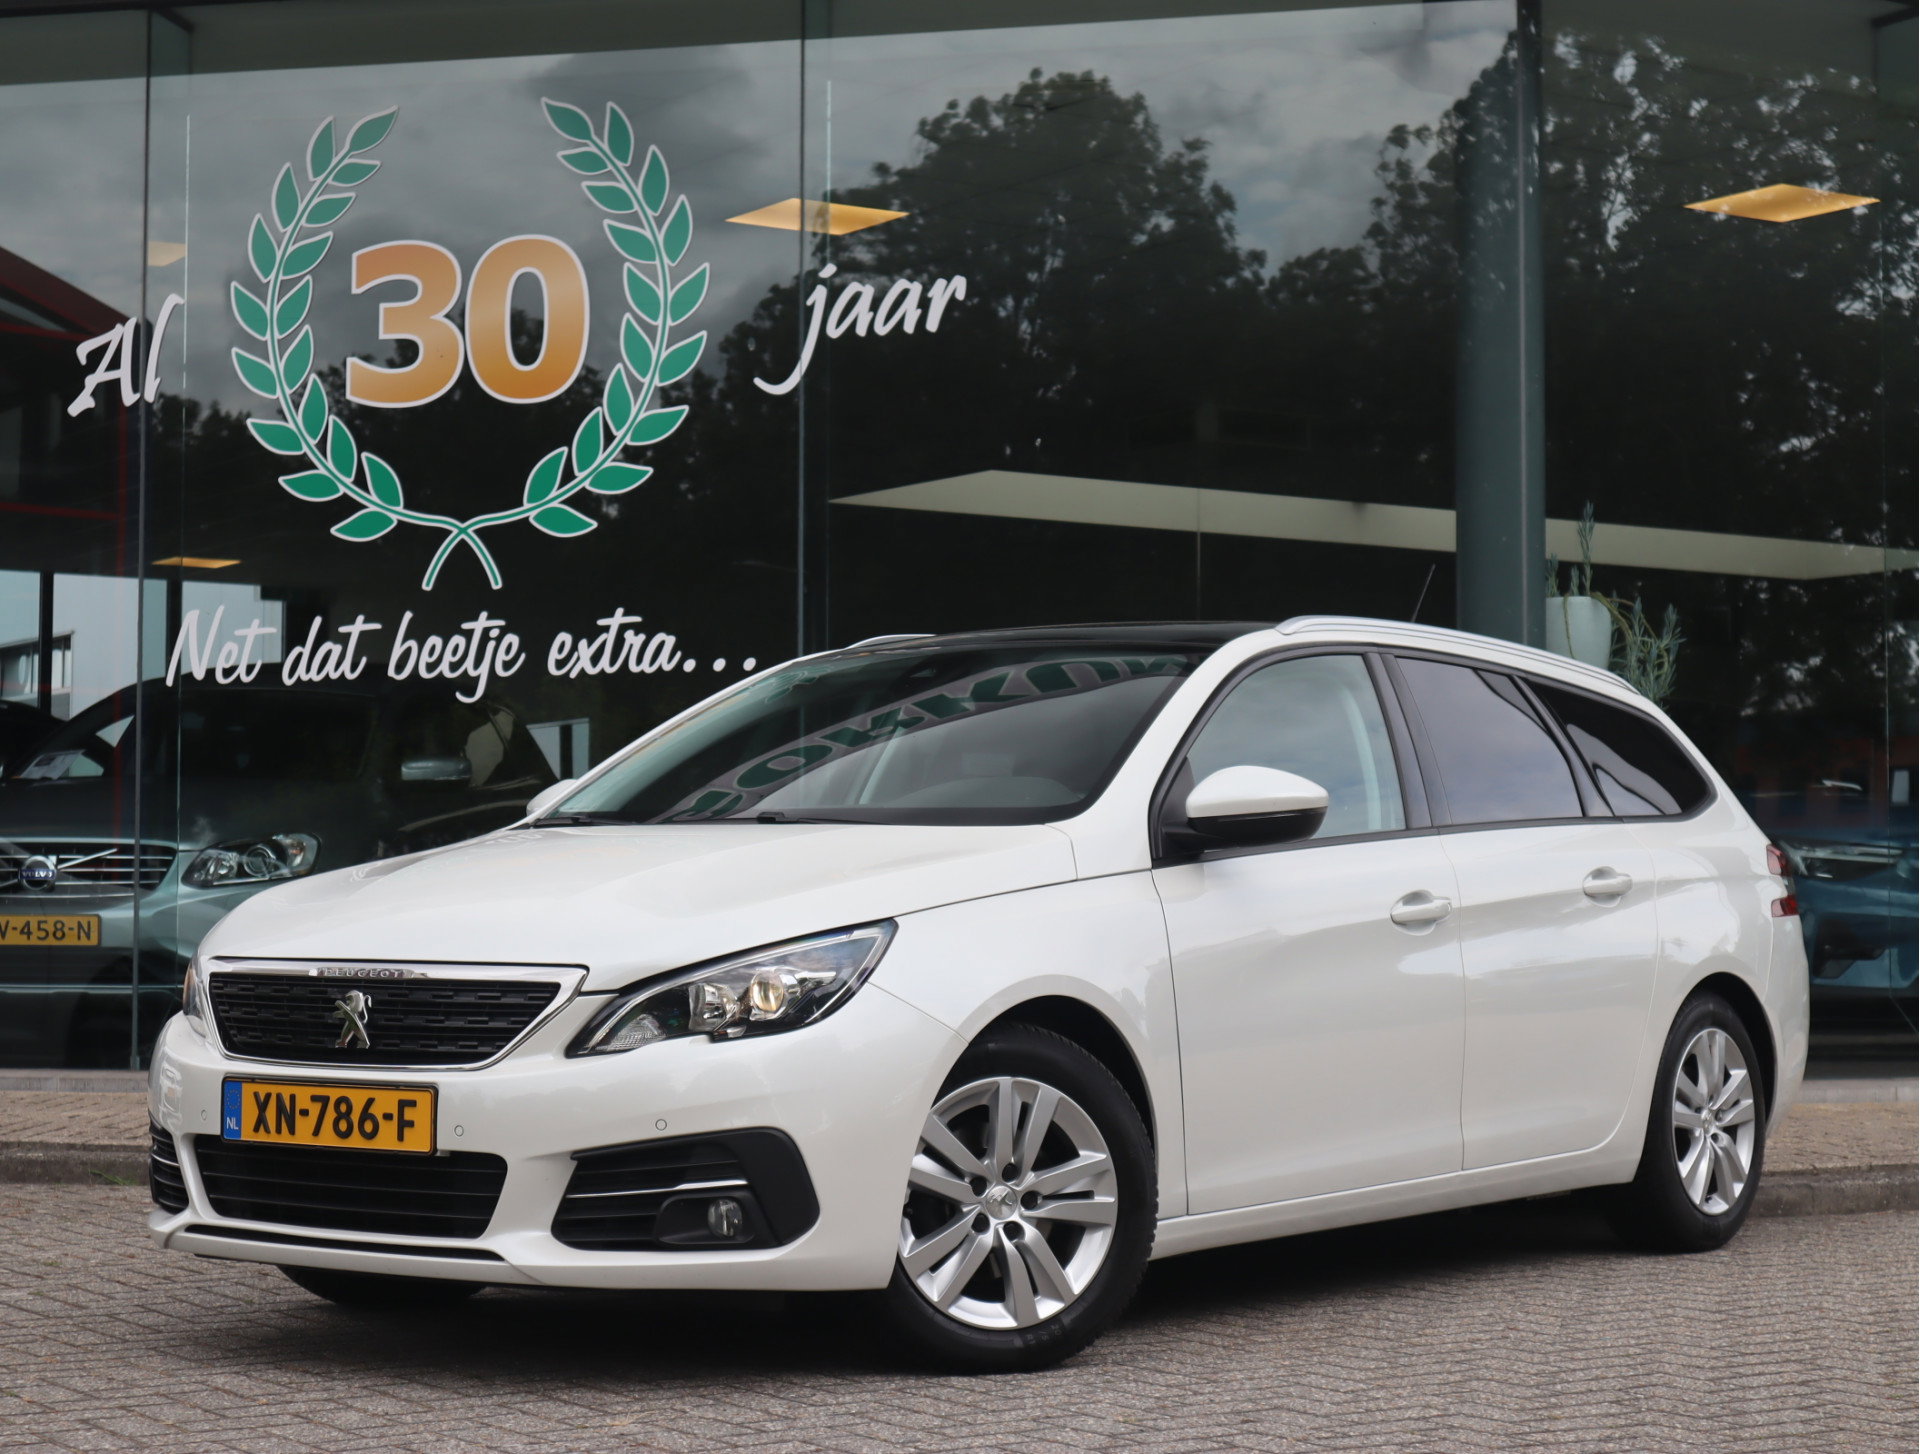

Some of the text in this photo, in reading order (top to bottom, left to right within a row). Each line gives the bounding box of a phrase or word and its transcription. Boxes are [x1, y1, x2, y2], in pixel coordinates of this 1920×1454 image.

[67, 294, 184, 416] Al
[345, 234, 590, 408] 30
[753, 262, 967, 395] jaar
[166, 605, 757, 703] Net dat beetje extra...
[324, 967, 402, 978] PEUGEOT
[226, 1117, 239, 1130] NL
[252, 1090, 417, 1142] XN-786-F
